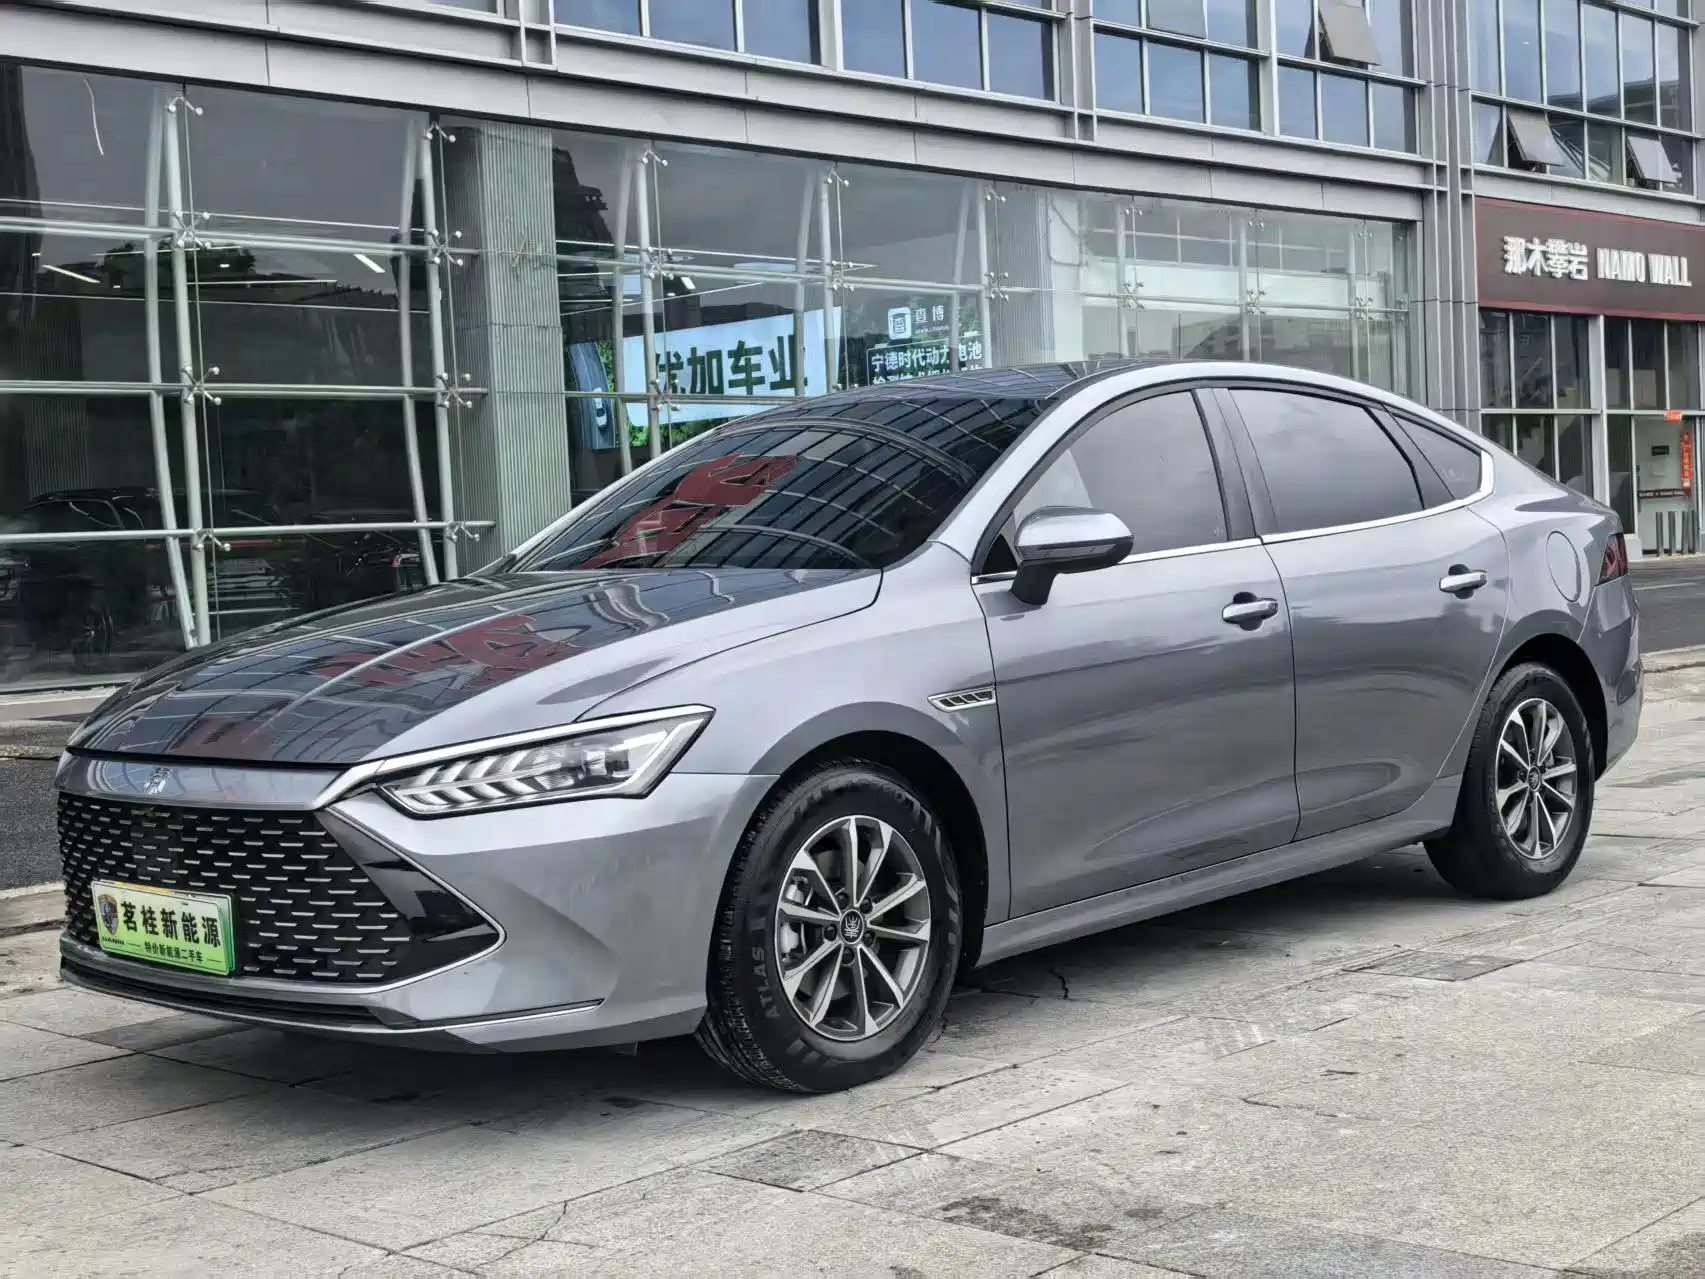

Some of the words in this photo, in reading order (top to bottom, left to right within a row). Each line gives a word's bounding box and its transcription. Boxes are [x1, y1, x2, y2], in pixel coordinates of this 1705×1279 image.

[1597, 248, 1645, 282] NAMO
[1648, 253, 1692, 287] WALL
[120, 901, 221, 948] 茗桂新能源
[751, 946, 780, 1019] ATLAS
